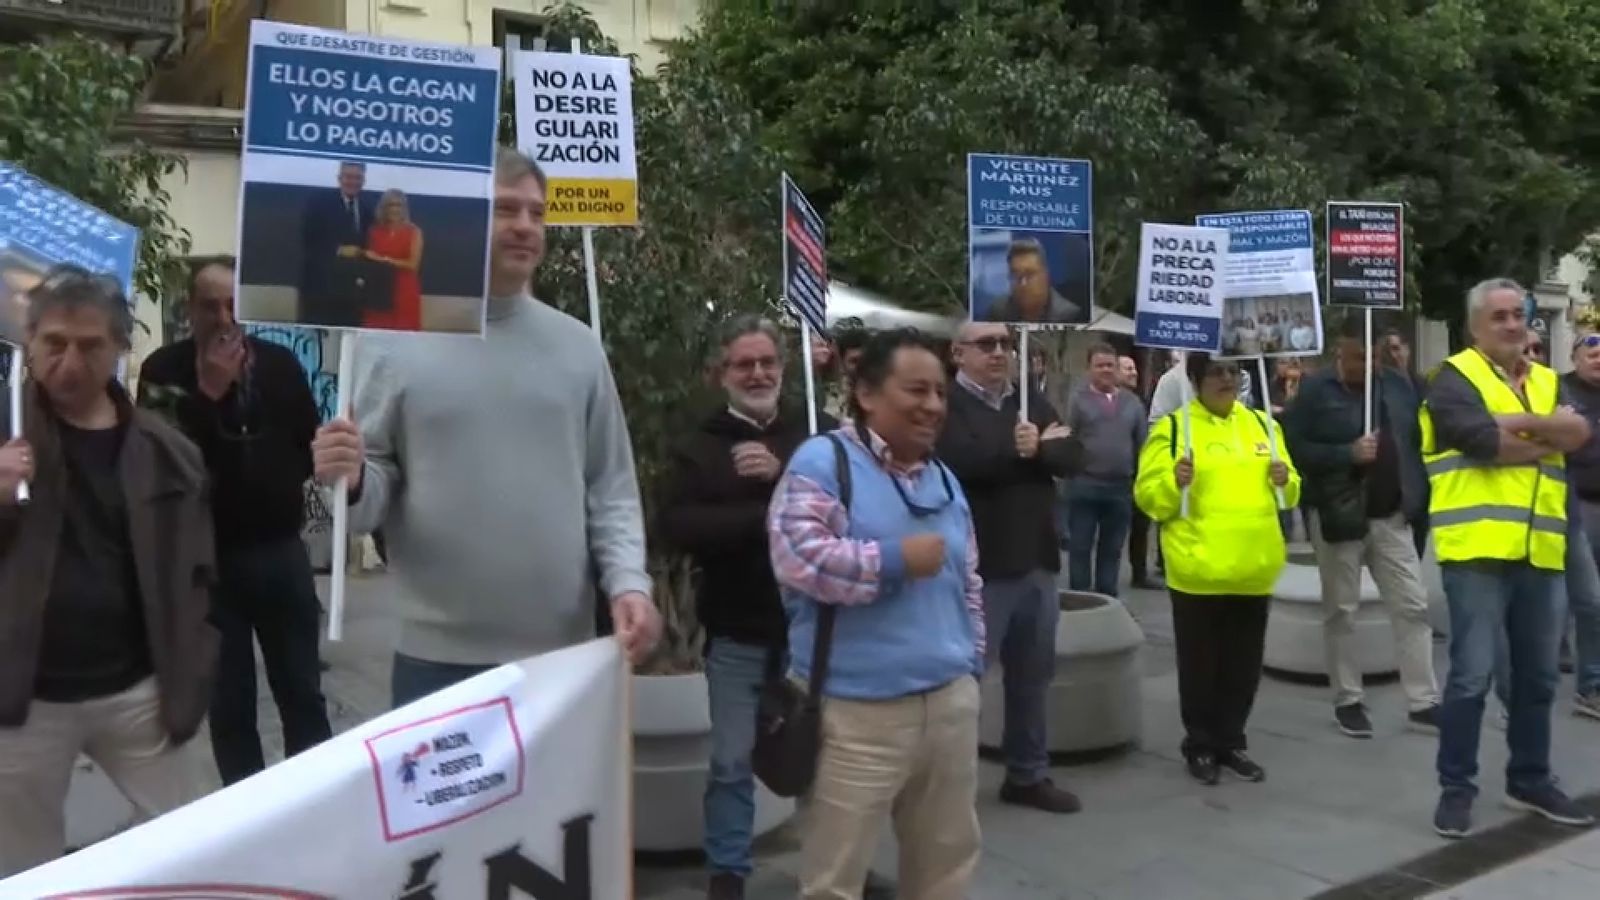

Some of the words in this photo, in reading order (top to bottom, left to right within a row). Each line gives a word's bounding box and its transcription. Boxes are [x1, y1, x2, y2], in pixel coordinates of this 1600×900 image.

[276, 31, 308, 46] QUE
[311, 35, 384, 56] DESASTRE
[389, 43, 408, 57] DE
[411, 44, 476, 64] GESTIÓN
[268, 63, 346, 90] ELLOS
[351, 71, 382, 94] LA
[388, 75, 476, 103] CAGAN
[532, 68, 568, 89] NO
[571, 73, 587, 90] A
[591, 73, 618, 92] LA
[289, 92, 308, 114] Y
[312, 95, 453, 127] NOSOTROS
[534, 94, 618, 115] DESRE
[286, 121, 321, 143] LO
[326, 125, 453, 155] PAGAMOS
[534, 119, 619, 139] GULARI
[536, 141, 620, 163] ZACIÓN
[990, 160, 1071, 173] VICENTE
[980, 171, 1080, 186] MARTINEZ
[555, 187, 584, 199] POR
[588, 188, 610, 199] UN
[1009, 185, 1053, 197] MUS
[578, 202, 624, 213] DIGNO
[980, 199, 1080, 214] RESPONSABLE
[984, 214, 1004, 226] DE
[1009, 215, 1029, 226] TU
[1032, 215, 1076, 227] RUINA
[1152, 237, 1178, 252] NO
[1181, 239, 1195, 252] A
[1197, 239, 1217, 254] LA
[1152, 254, 1215, 272] PRECA
[1150, 271, 1214, 289] RIEDAD
[1148, 289, 1212, 306] LABORAL
